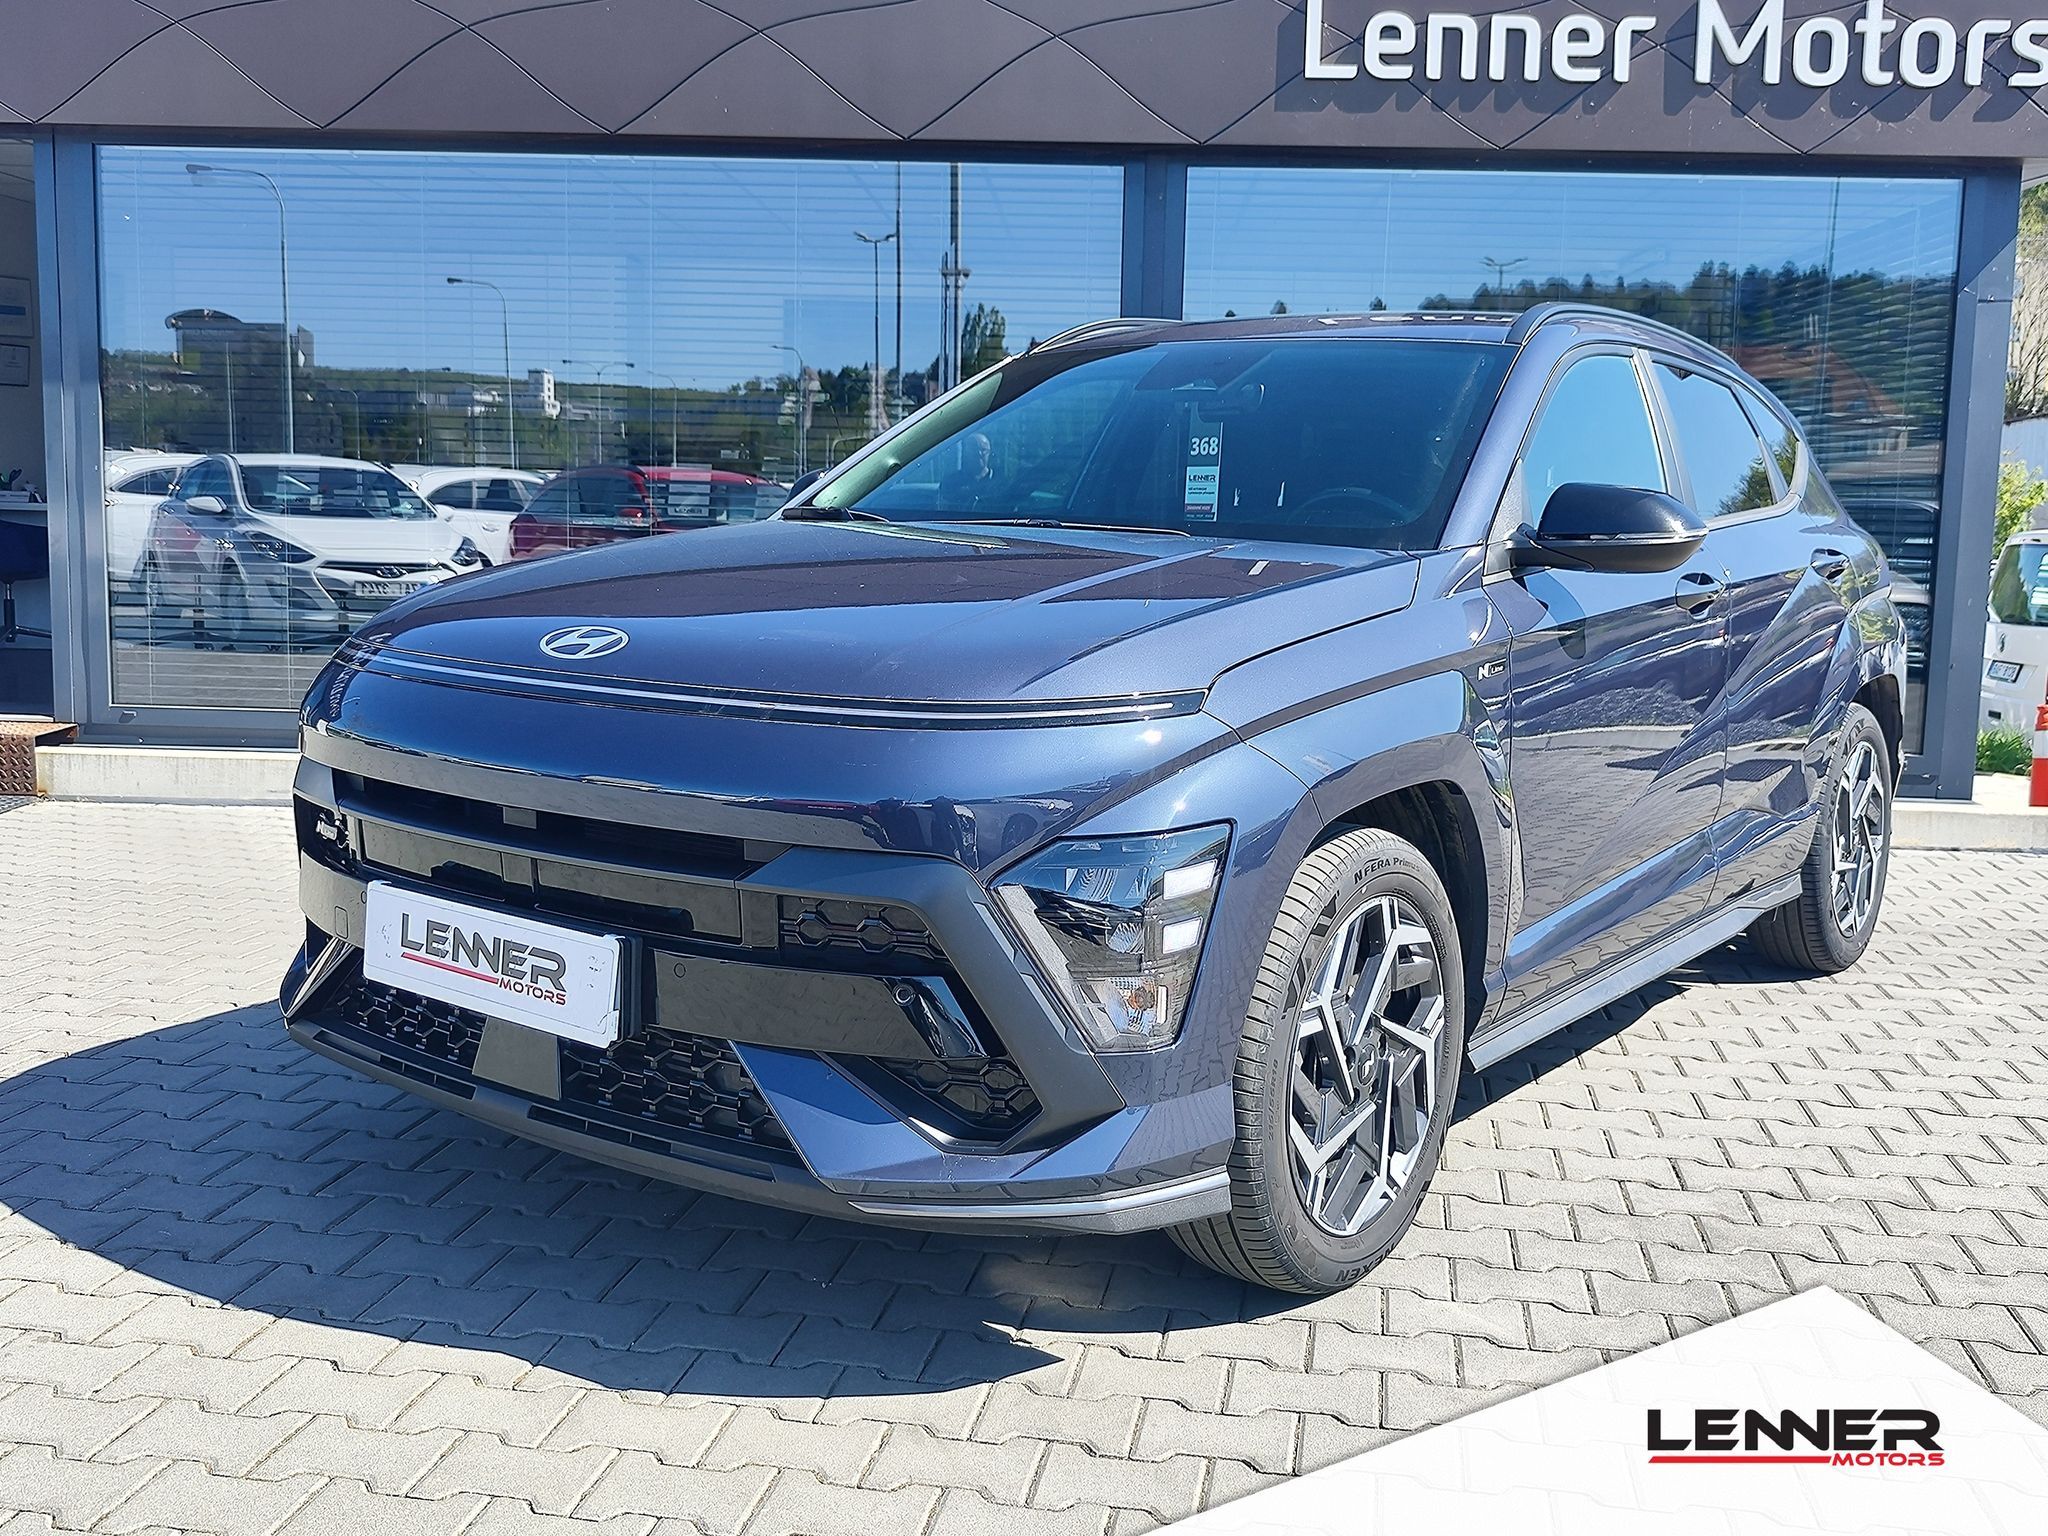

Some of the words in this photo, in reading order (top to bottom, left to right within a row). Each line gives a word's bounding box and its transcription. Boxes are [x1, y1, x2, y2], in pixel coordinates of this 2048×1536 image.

[1304, 0, 1657, 84] Lenner
[1694, 0, 2048, 88] Motors
[1190, 437, 1218, 455] 368
[401, 913, 567, 991] LENNER
[499, 979, 567, 1005] MOTORS
